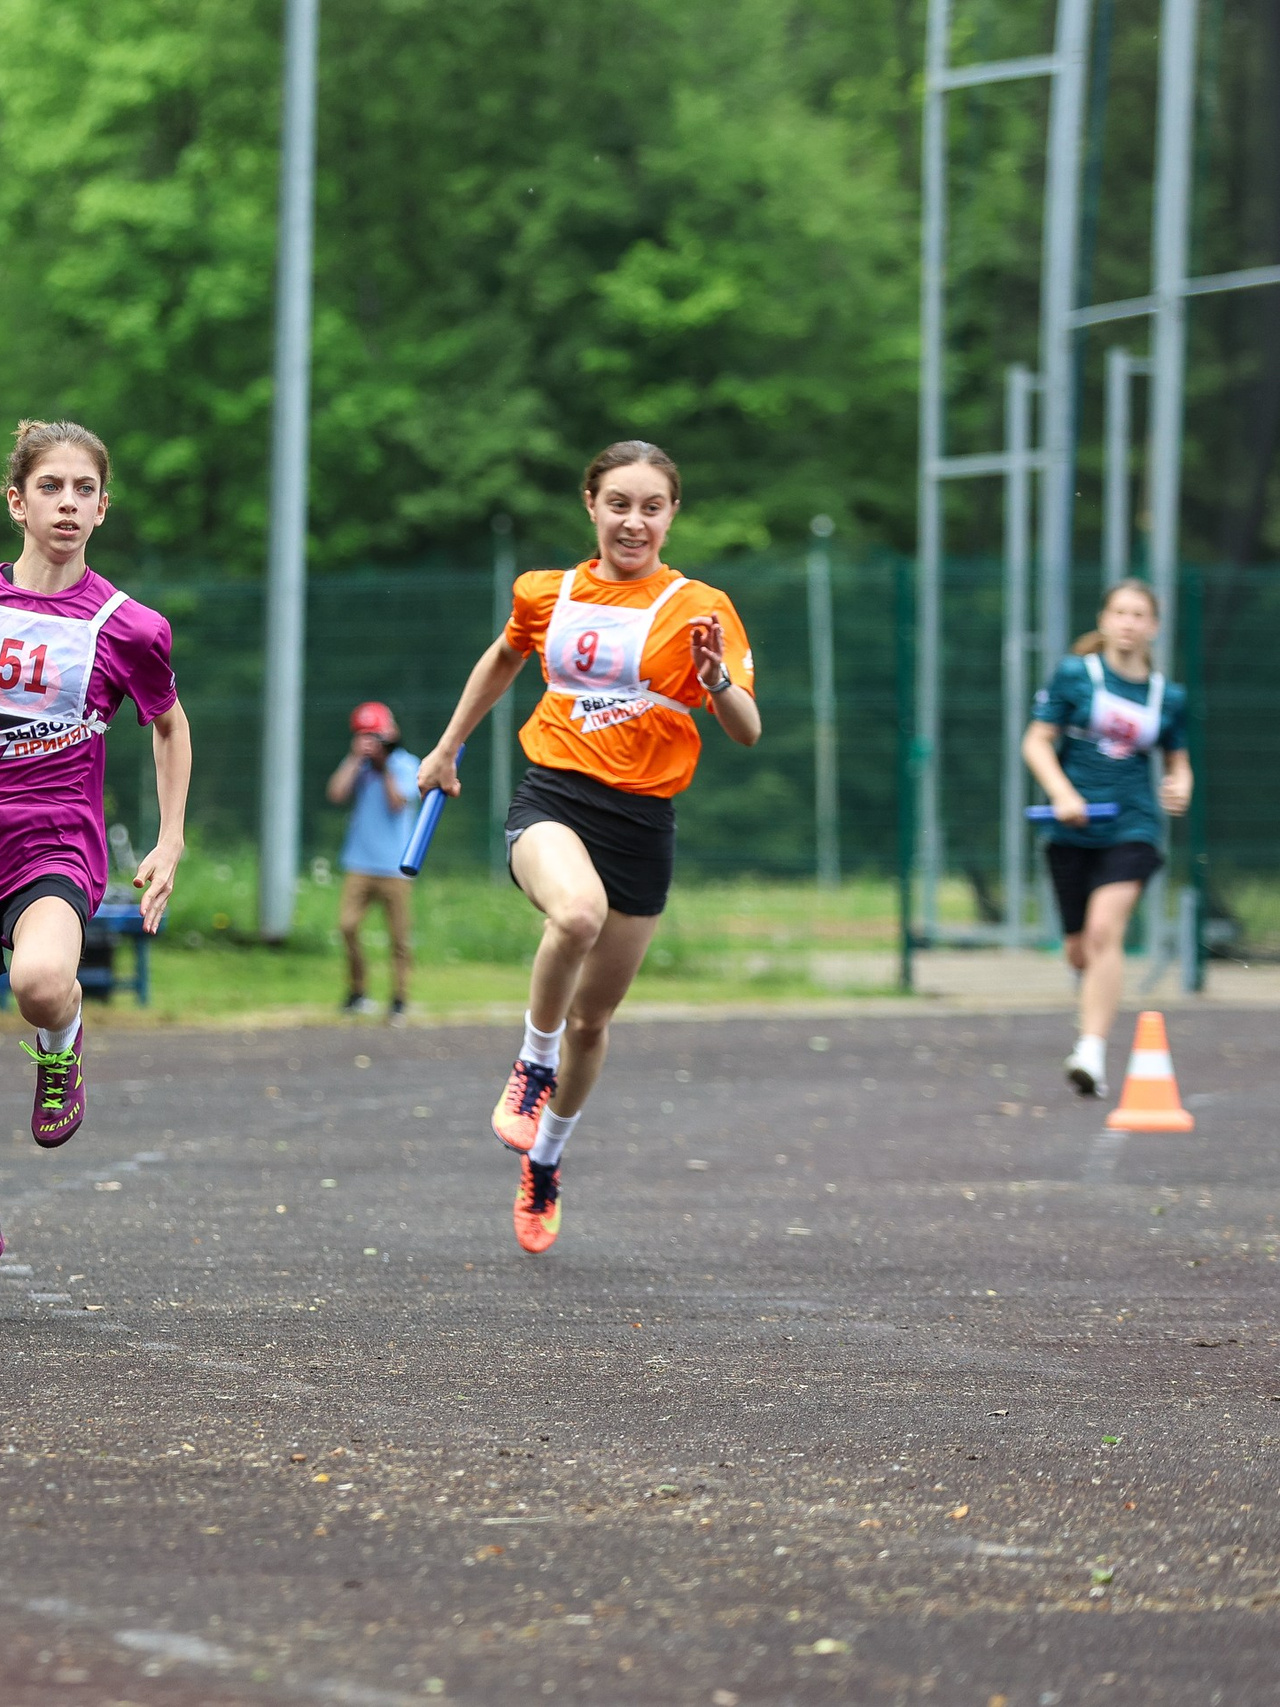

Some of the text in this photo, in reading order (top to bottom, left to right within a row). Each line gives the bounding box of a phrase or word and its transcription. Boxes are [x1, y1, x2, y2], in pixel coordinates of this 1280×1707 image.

[575, 630, 599, 672] 9
[5, 720, 74, 741] ВЫЗО
[14, 724, 89, 756] ПРИНЯТ
[40, 1102, 81, 1132] HEALTH
